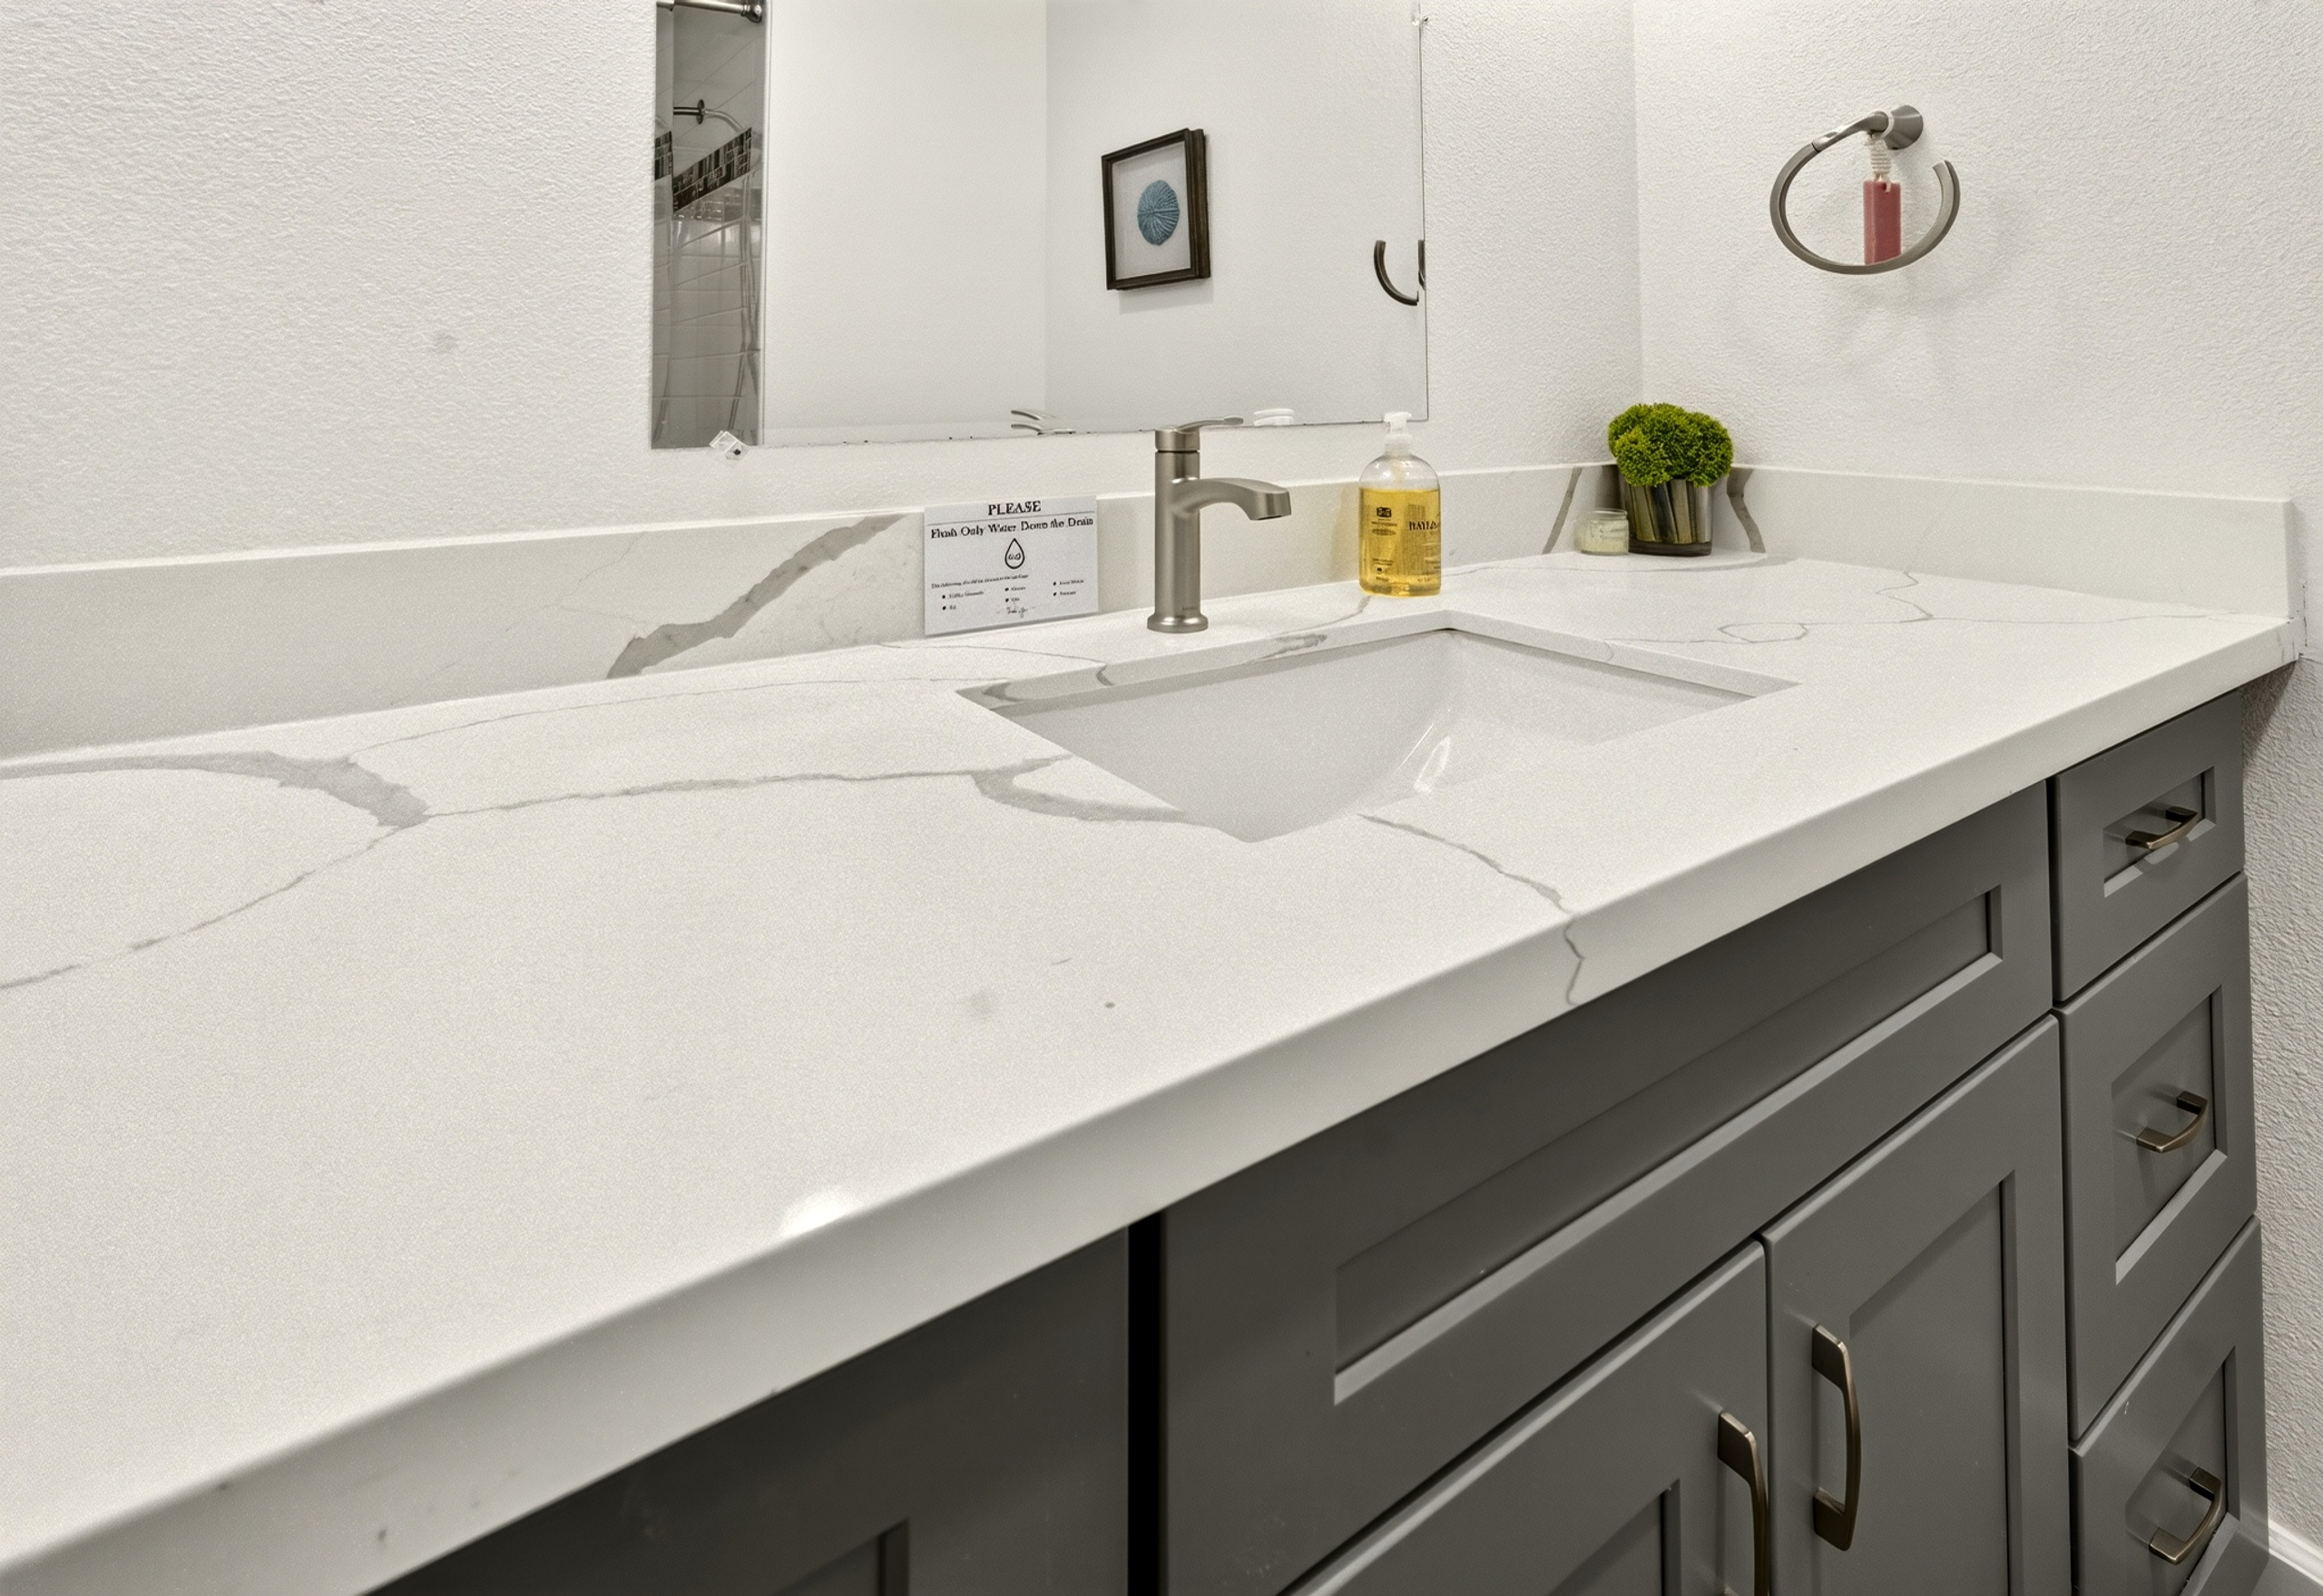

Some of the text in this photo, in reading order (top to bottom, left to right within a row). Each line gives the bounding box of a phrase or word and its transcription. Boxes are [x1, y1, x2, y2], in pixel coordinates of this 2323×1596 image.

[988, 500, 1042, 515] PLEASE
[931, 515, 1093, 539] Flush Only Water Down the Drain
